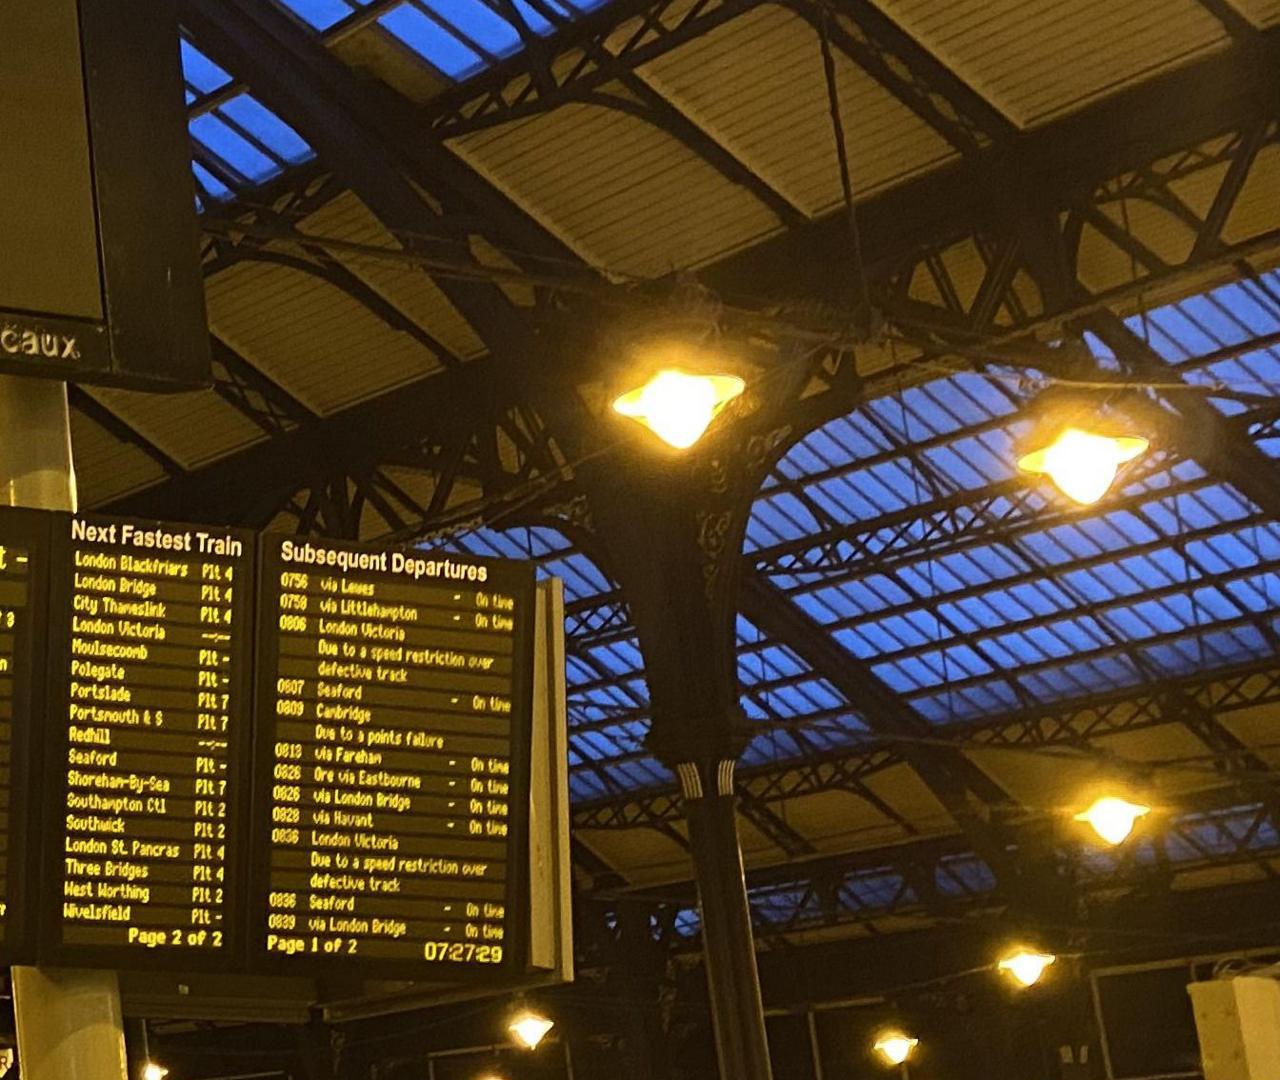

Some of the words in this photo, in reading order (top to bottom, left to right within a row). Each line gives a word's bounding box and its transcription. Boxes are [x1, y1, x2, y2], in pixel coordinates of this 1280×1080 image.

[71, 519, 117, 544] Next
[121, 524, 192, 552] Fastest
[195, 532, 242, 557] Train
[74, 550, 117, 570] London
[120, 554, 189, 578] Blackfriars
[202, 563, 222, 581] Plt
[224, 566, 233, 582] 4
[281, 540, 387, 572] Subsequent
[391, 552, 488, 582] Departures
[74, 572, 117, 592] London
[119, 576, 157, 599] Bridge
[201, 584, 221, 602] Plt
[224, 587, 233, 603] 4
[128, 927, 167, 948] Page
[171, 929, 182, 945] 2
[187, 929, 207, 946] of
[212, 930, 223, 947] 2
[267, 934, 305, 955] Page
[311, 936, 318, 953] 1
[323, 937, 343, 953] of
[347, 938, 358, 954] 2
[424, 941, 503, 964] 07:27:29
